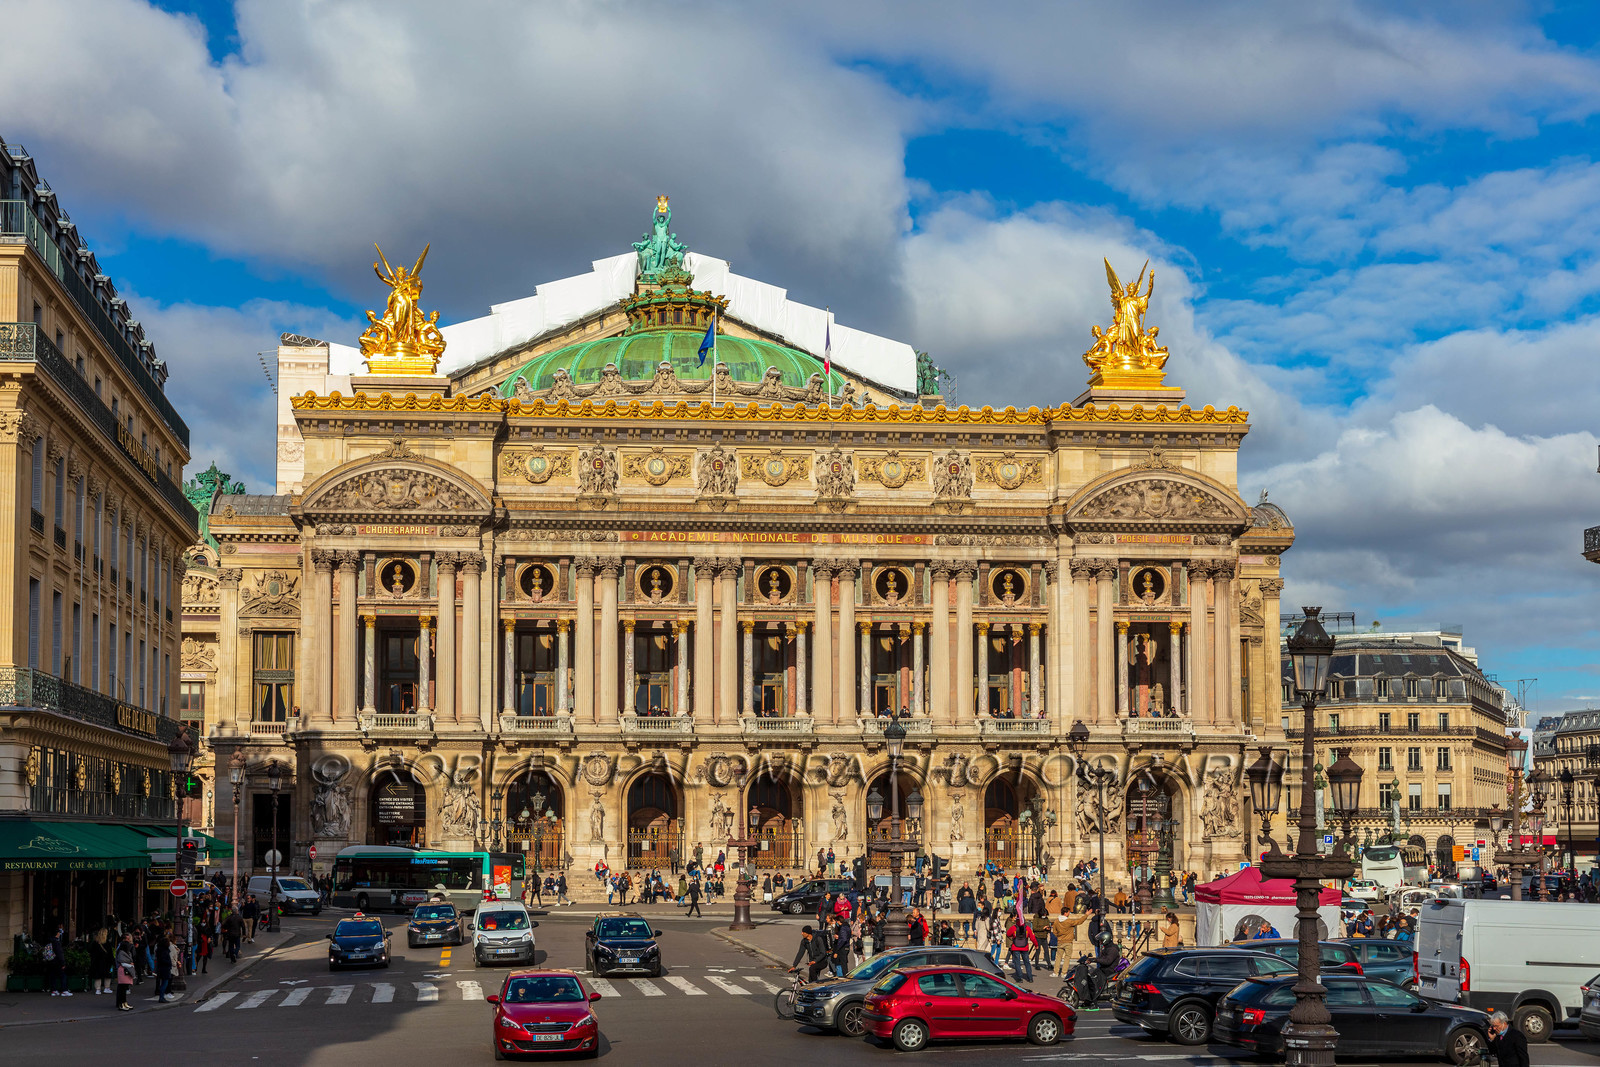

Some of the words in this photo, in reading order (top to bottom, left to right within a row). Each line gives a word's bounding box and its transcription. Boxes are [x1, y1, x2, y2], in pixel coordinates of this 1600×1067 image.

[365, 526, 430, 535] CHOREGRAPHIE
[650, 532, 720, 543] ACADEMIE
[732, 533, 799, 543] NATIONALE
[811, 533, 829, 543] DE
[841, 534, 903, 544] MUSIQUE
[1121, 535, 1150, 543] POESIE
[1154, 535, 1186, 544] LYRIQUE
[69, 860, 85, 869] CAFÉ
